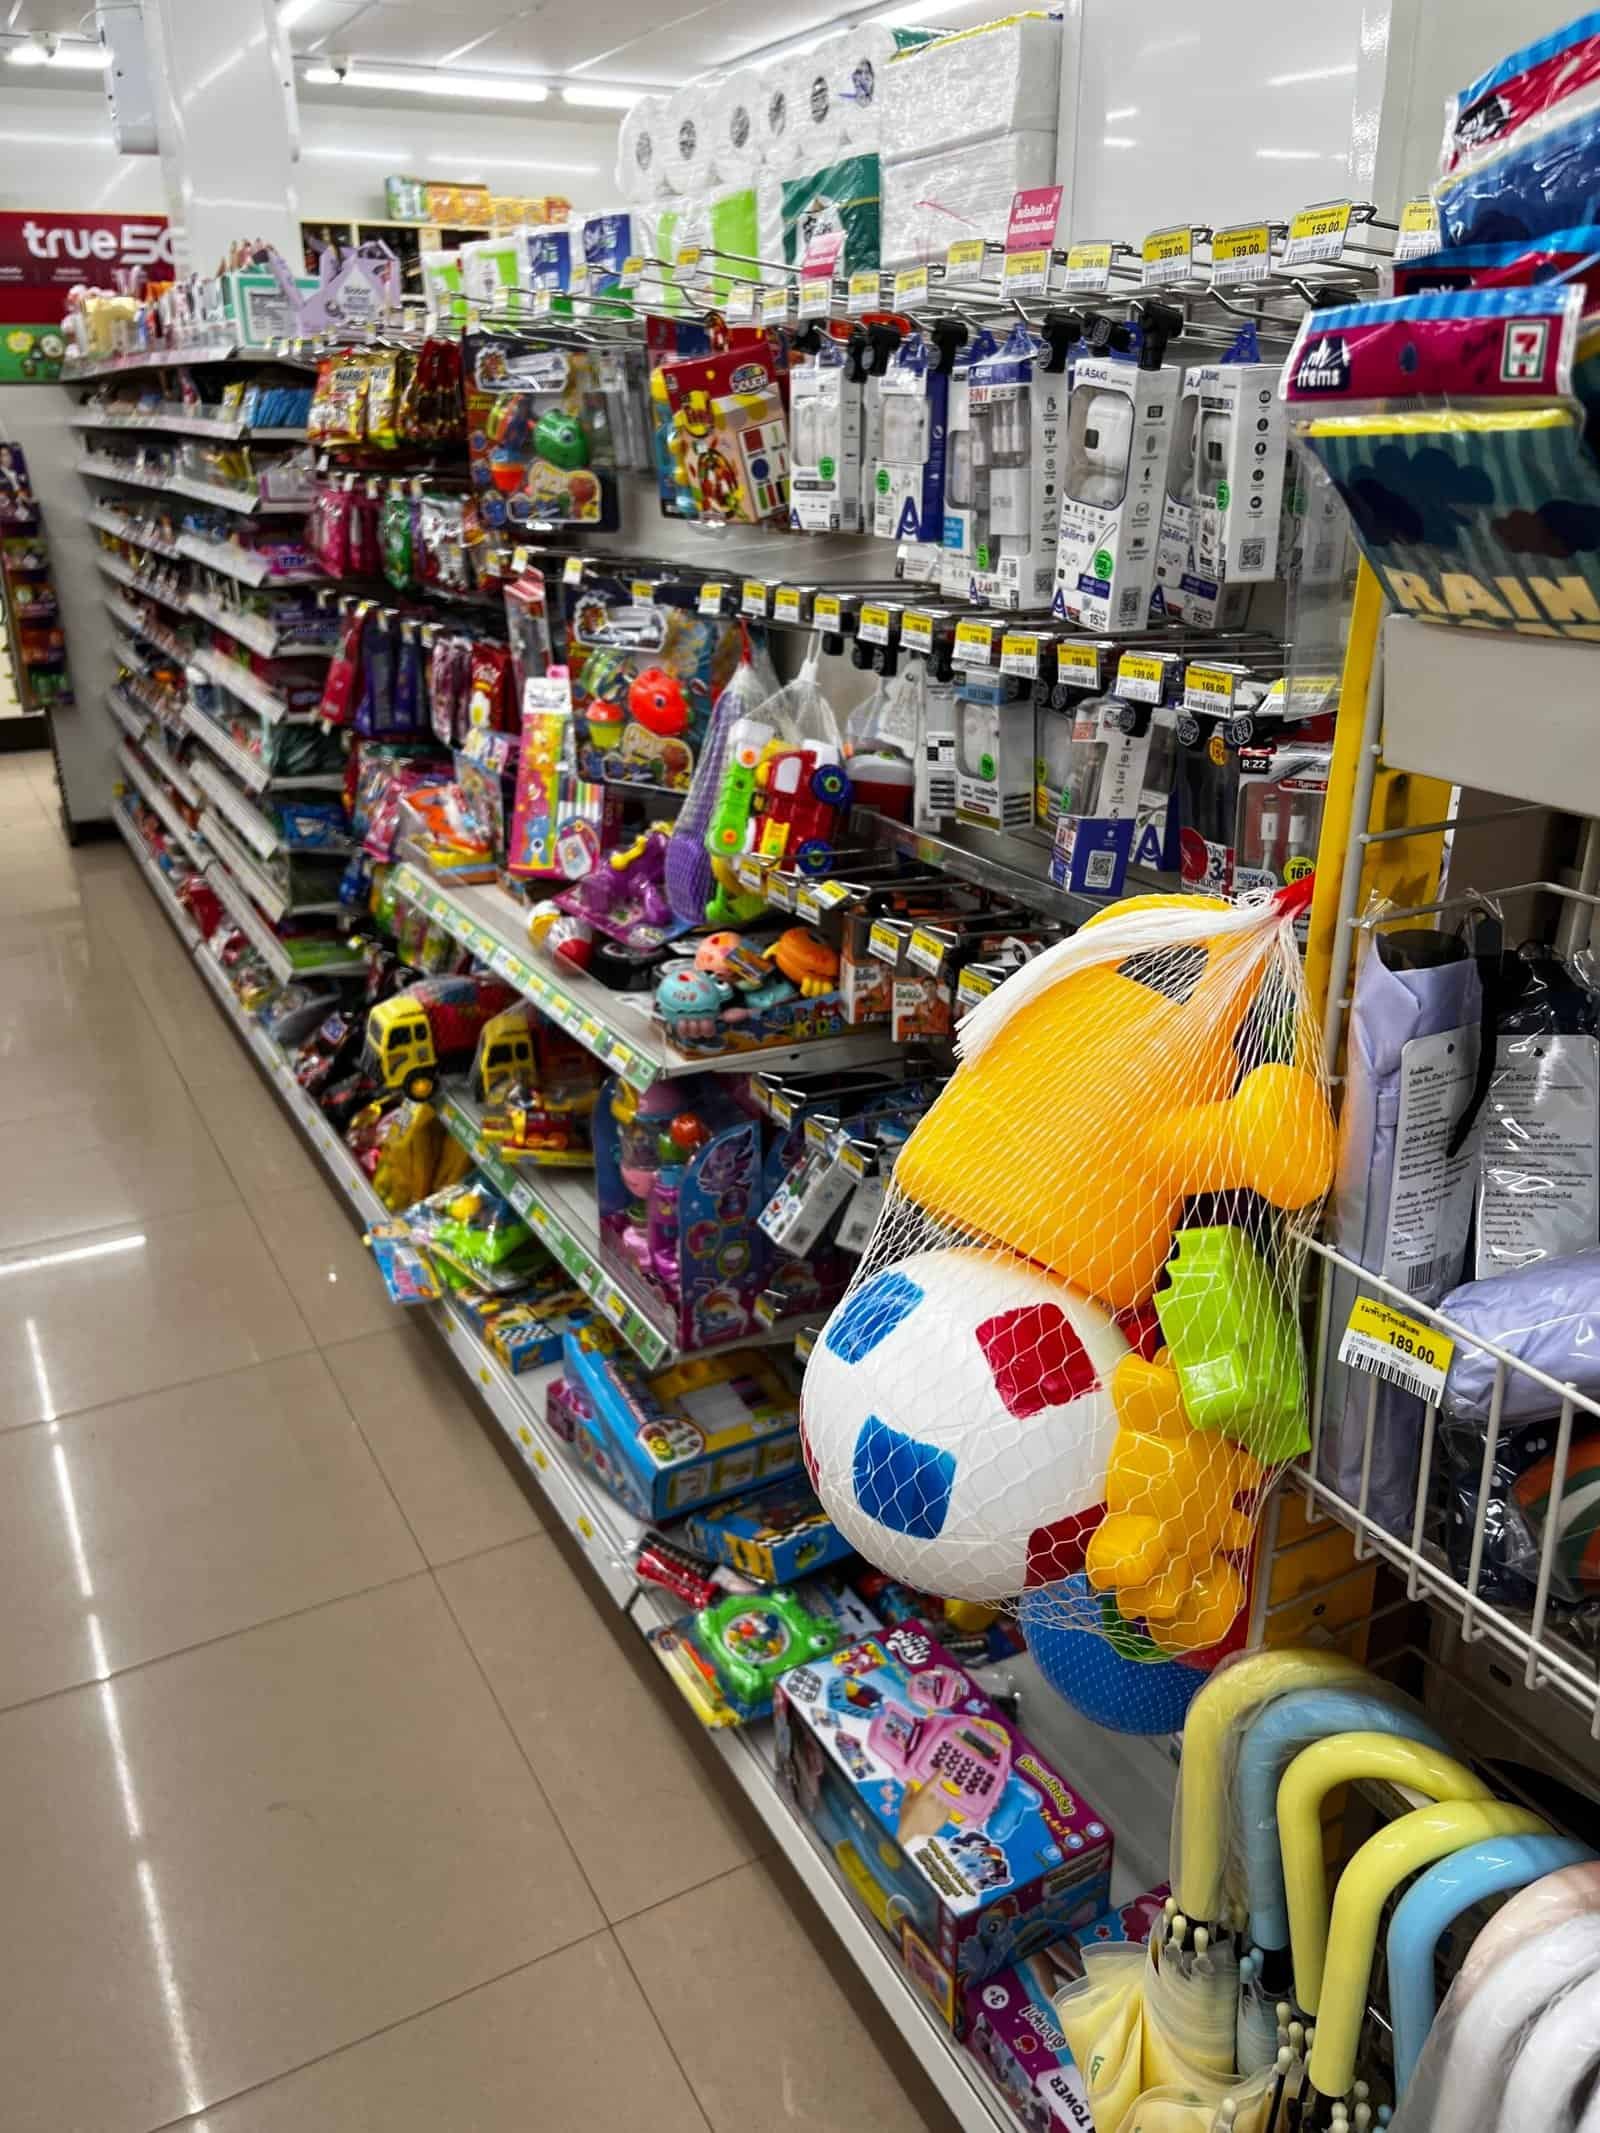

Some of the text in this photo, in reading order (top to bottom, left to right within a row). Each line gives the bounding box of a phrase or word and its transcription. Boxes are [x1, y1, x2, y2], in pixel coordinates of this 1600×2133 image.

[22, 220, 117, 260] true
[1311, 221, 1339, 236] 159.00
[1232, 243, 1260, 257] 199.00
[1388, 1330, 1435, 1365] 189.00
[1051, 2075, 1091, 2128] TOWER
